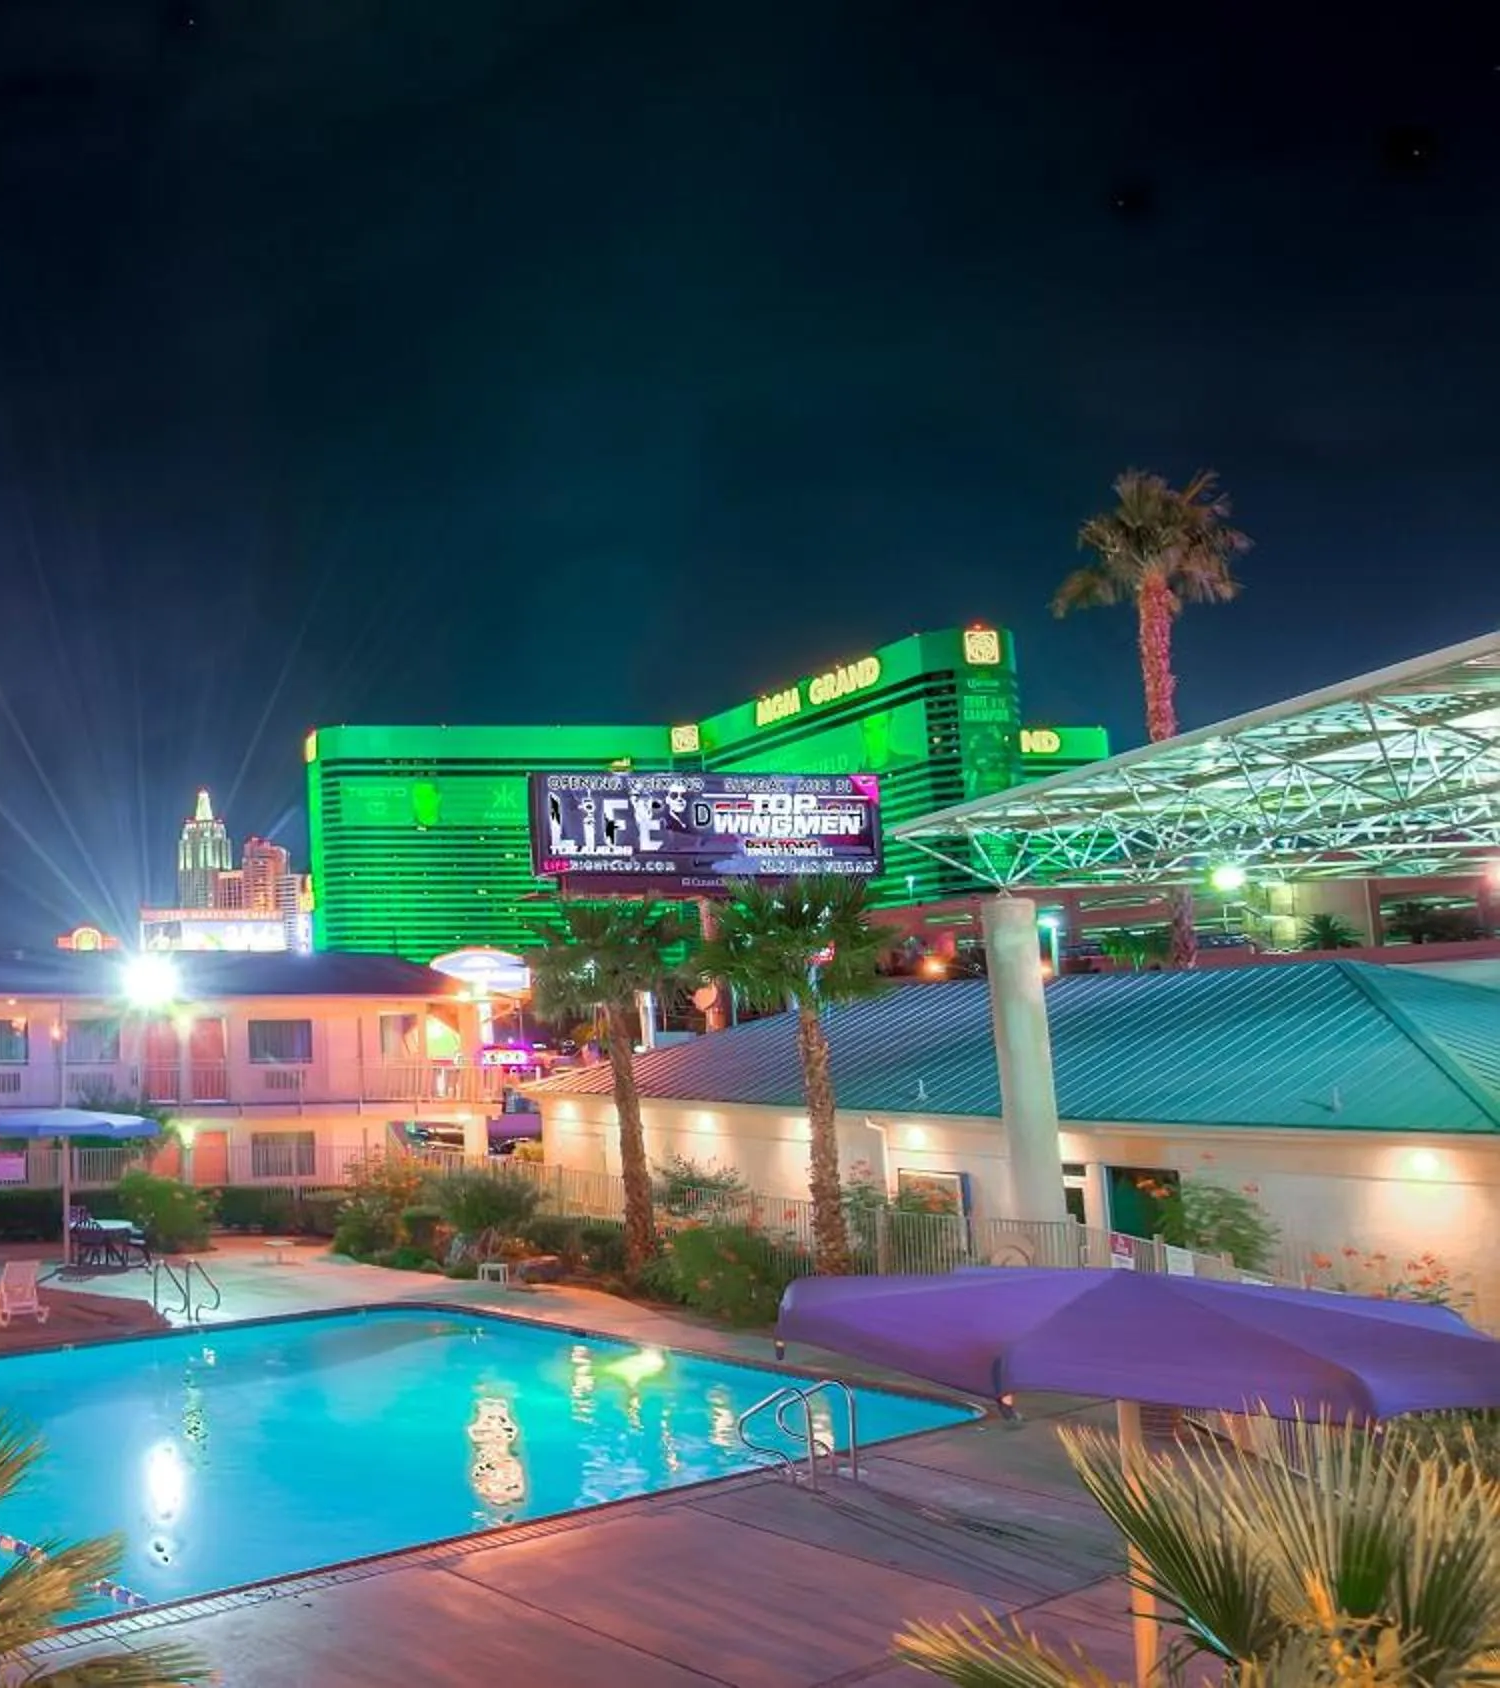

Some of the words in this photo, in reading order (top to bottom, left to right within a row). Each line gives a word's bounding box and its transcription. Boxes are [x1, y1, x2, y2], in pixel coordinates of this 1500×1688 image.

[756, 687, 800, 727] MGM
[809, 657, 880, 705] GRAND
[747, 794, 818, 815] TOP
[714, 814, 861, 835] WINGMEN
